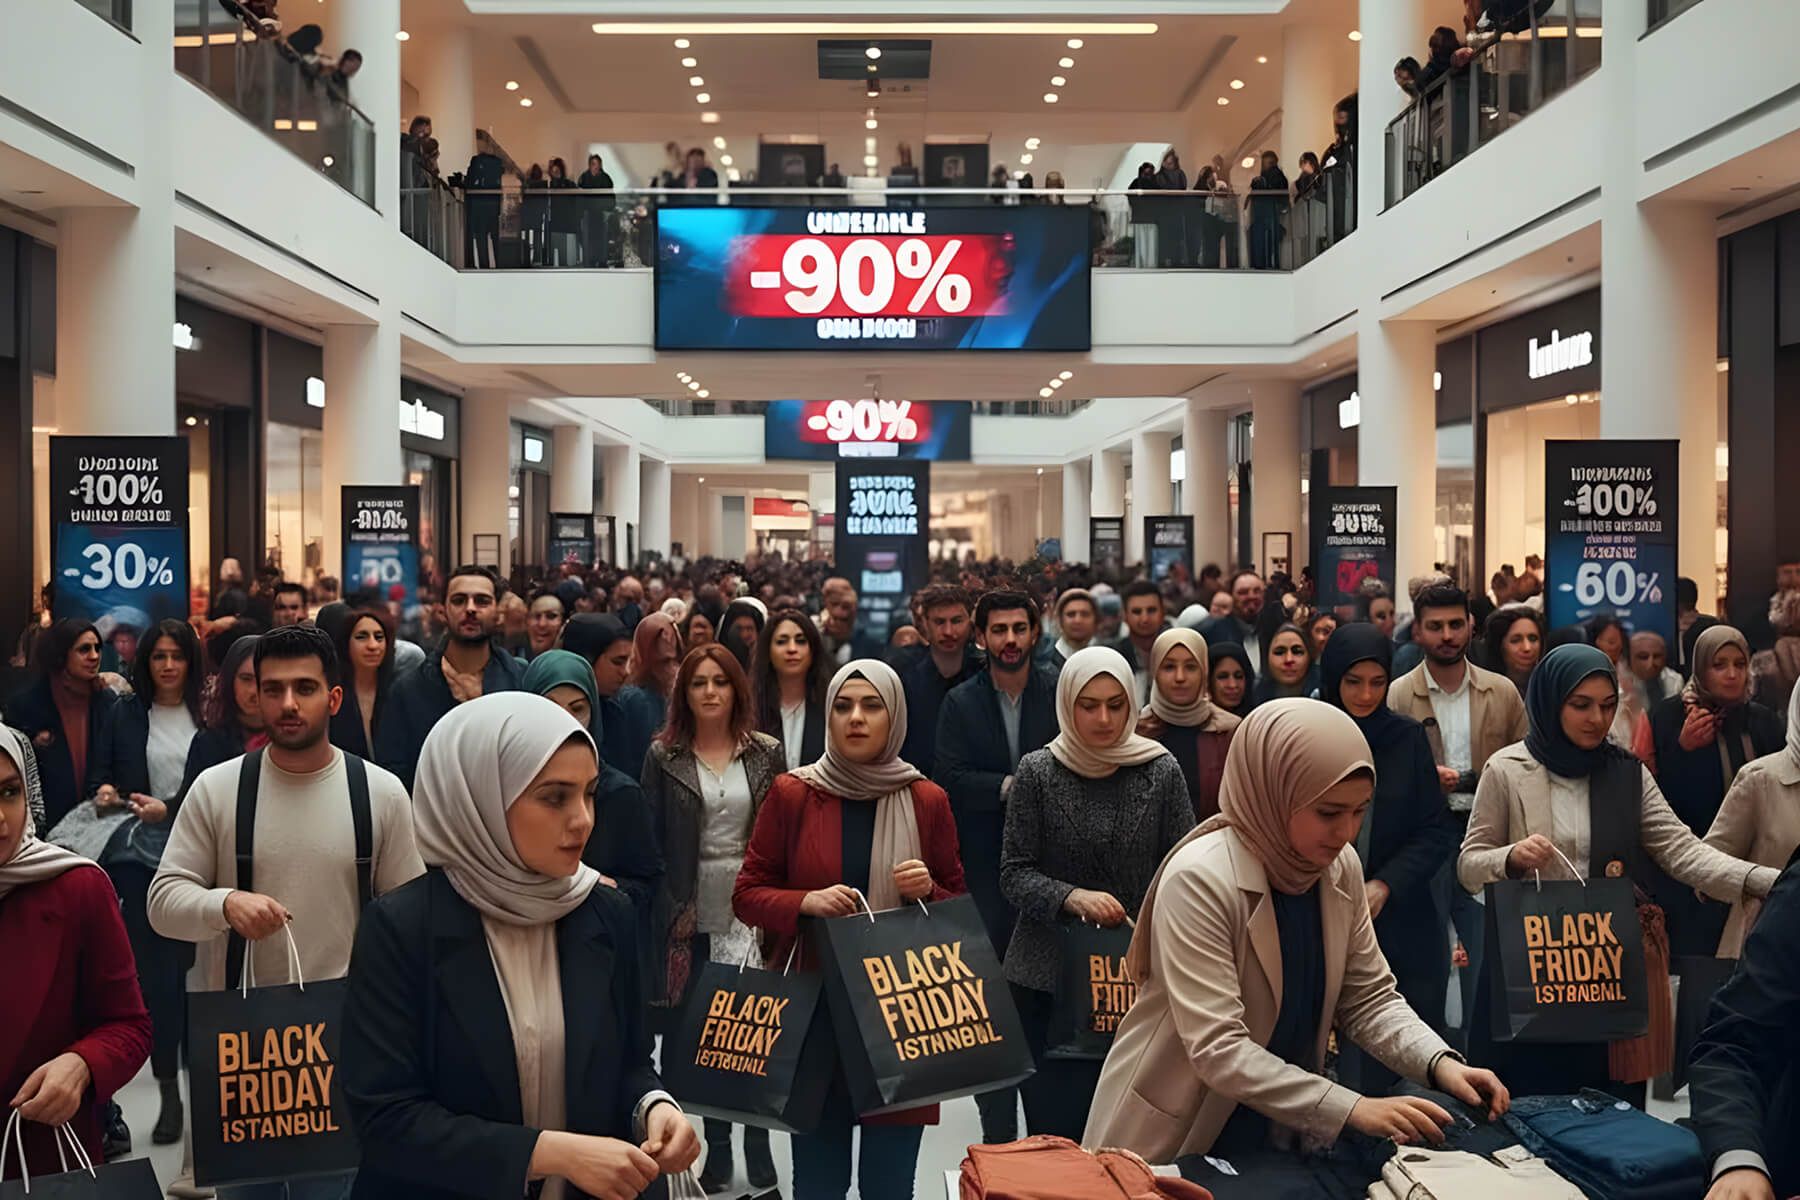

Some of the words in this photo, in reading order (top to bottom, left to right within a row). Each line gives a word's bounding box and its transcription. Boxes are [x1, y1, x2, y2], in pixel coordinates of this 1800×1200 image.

[750, 238, 972, 314] -90%
[808, 399, 918, 441] -90%
[63, 542, 174, 590] -30%
[1559, 560, 1663, 606] -60%
[1524, 912, 1619, 947] BLACK
[863, 940, 976, 996] BLACK
[1528, 946, 1623, 984] FRIDAY
[879, 978, 989, 1040] FRIDAY
[218, 1022, 330, 1073] BLACK
[219, 1064, 334, 1117] FRIDAY
[222, 1109, 340, 1143] ISTANBUL
